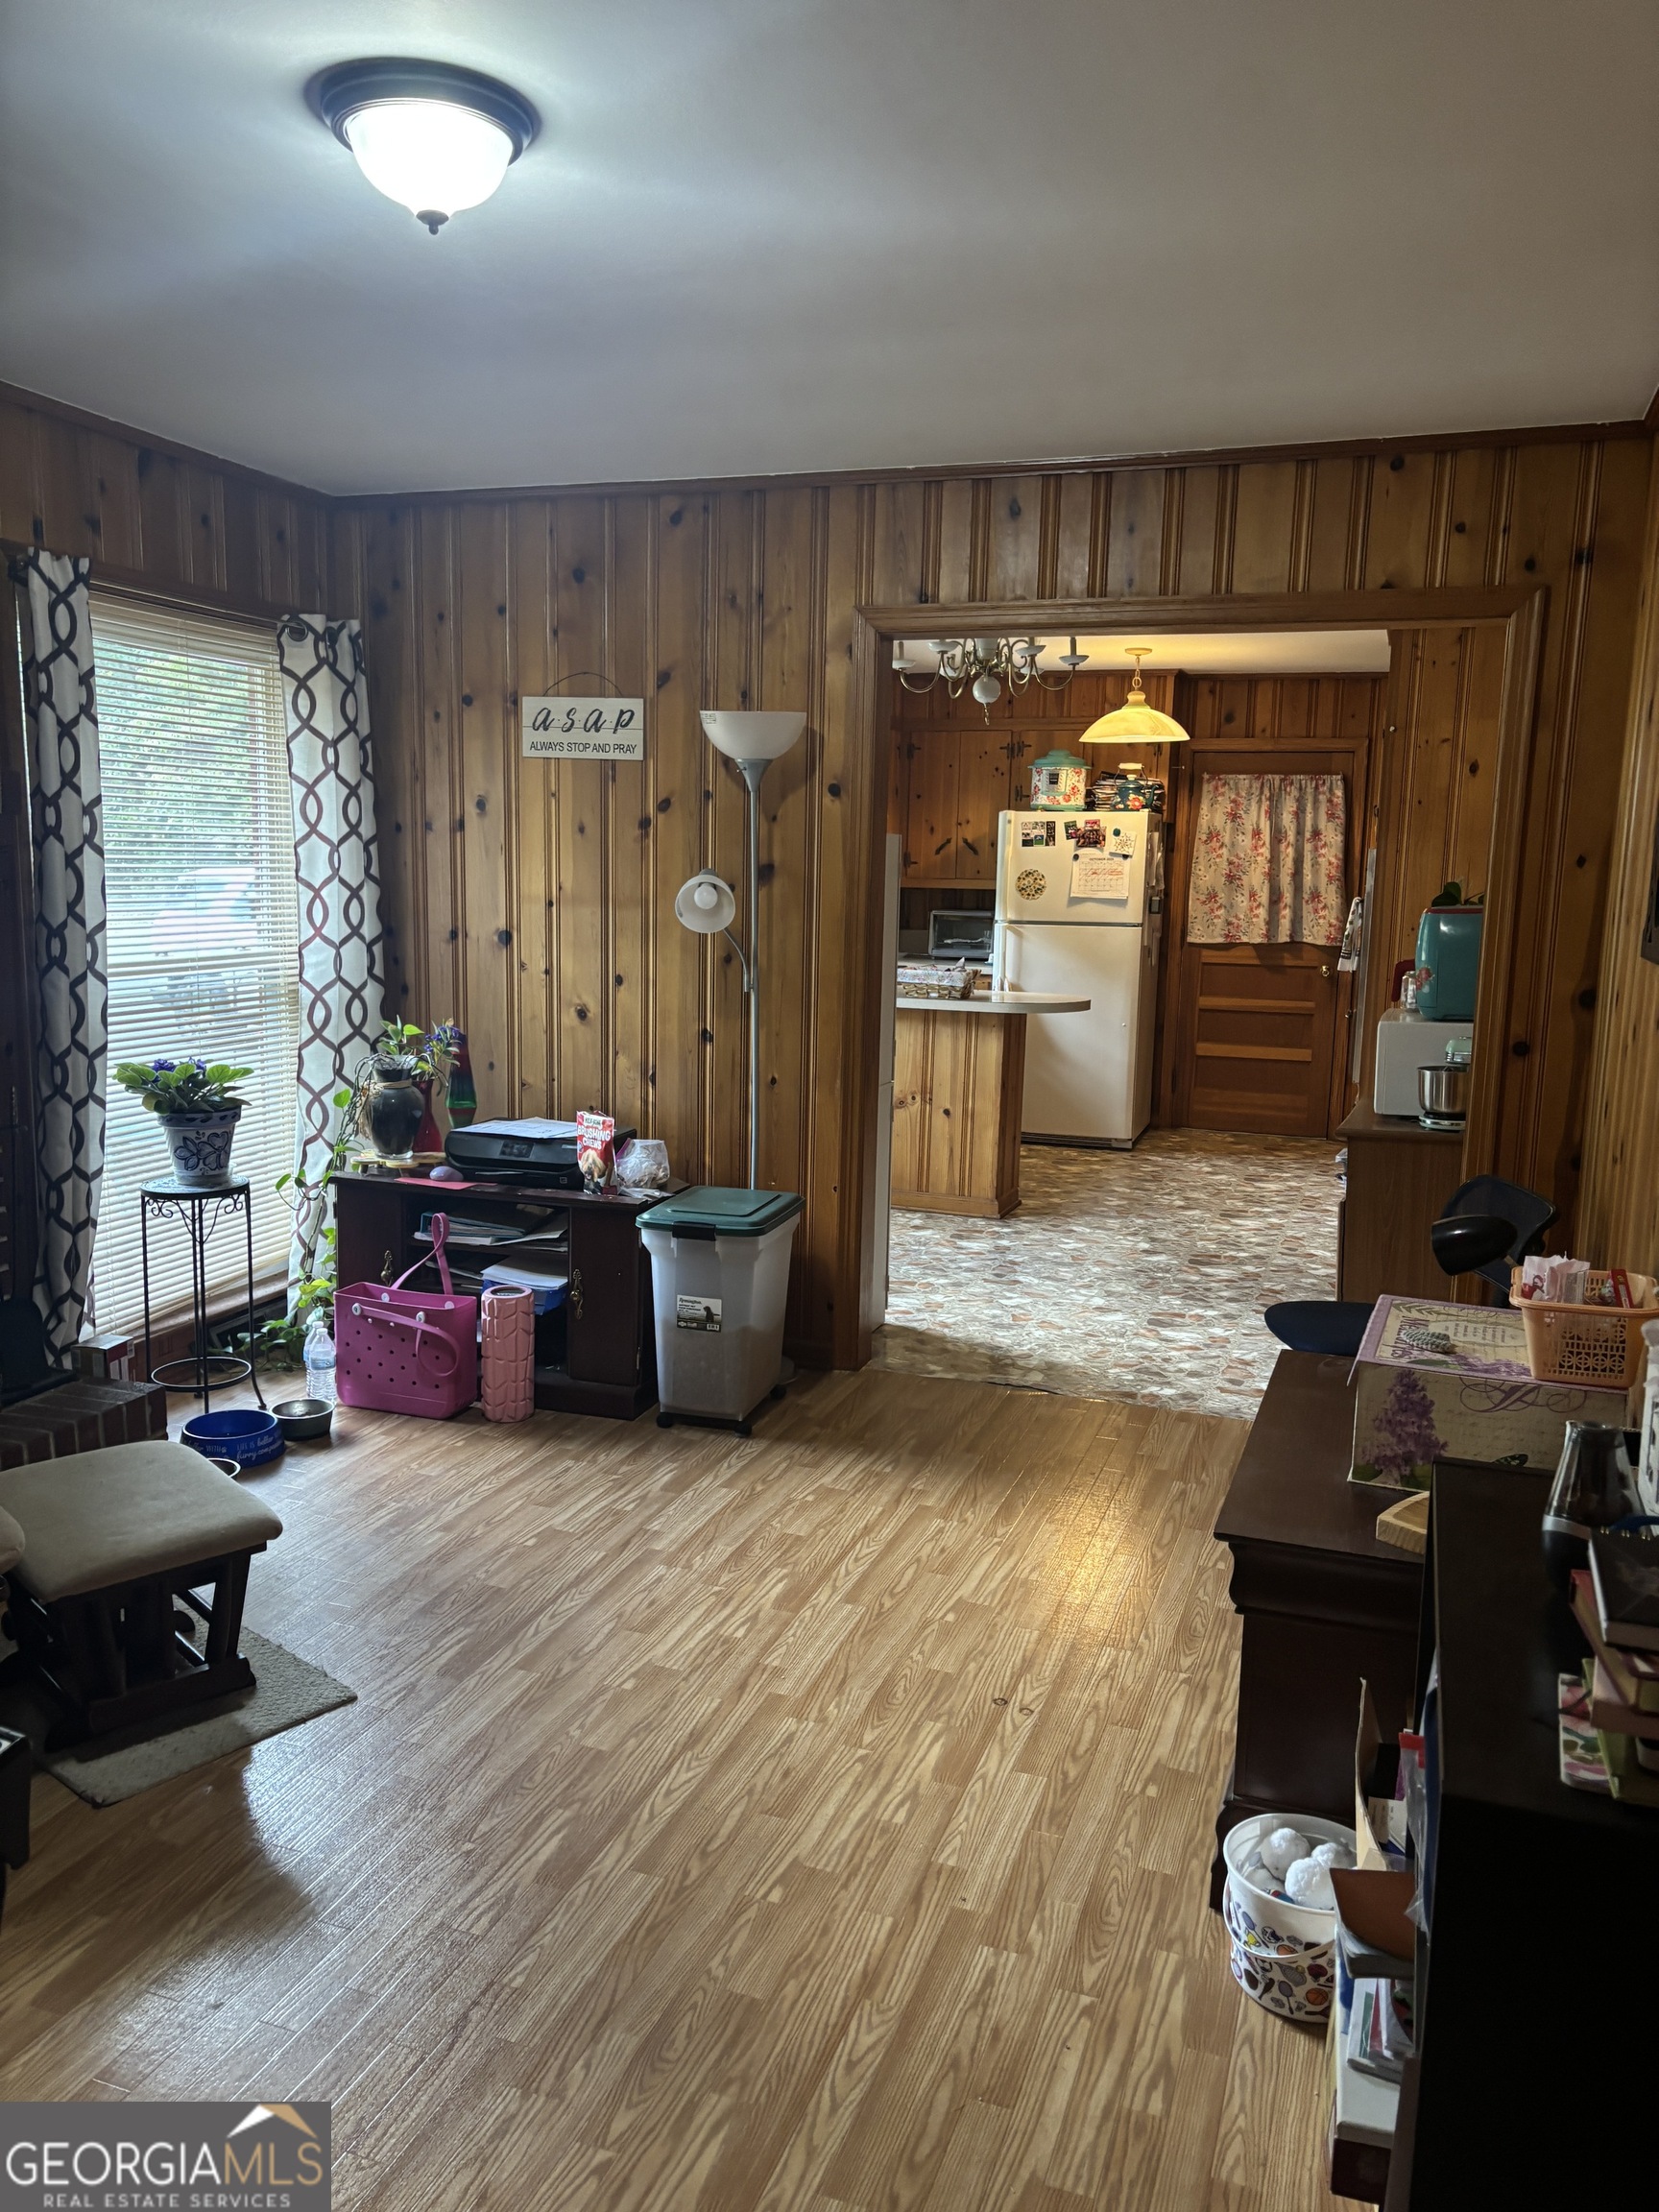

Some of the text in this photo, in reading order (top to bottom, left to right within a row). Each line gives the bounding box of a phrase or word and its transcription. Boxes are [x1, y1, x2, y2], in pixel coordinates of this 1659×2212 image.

[530, 741, 637, 755] ALWAYS STOP AND PRAY
[577, 1125, 611, 1141] BRUSHING
[583, 1137, 601, 1149] CHEWS
[236, 1451, 257, 1462] furry
